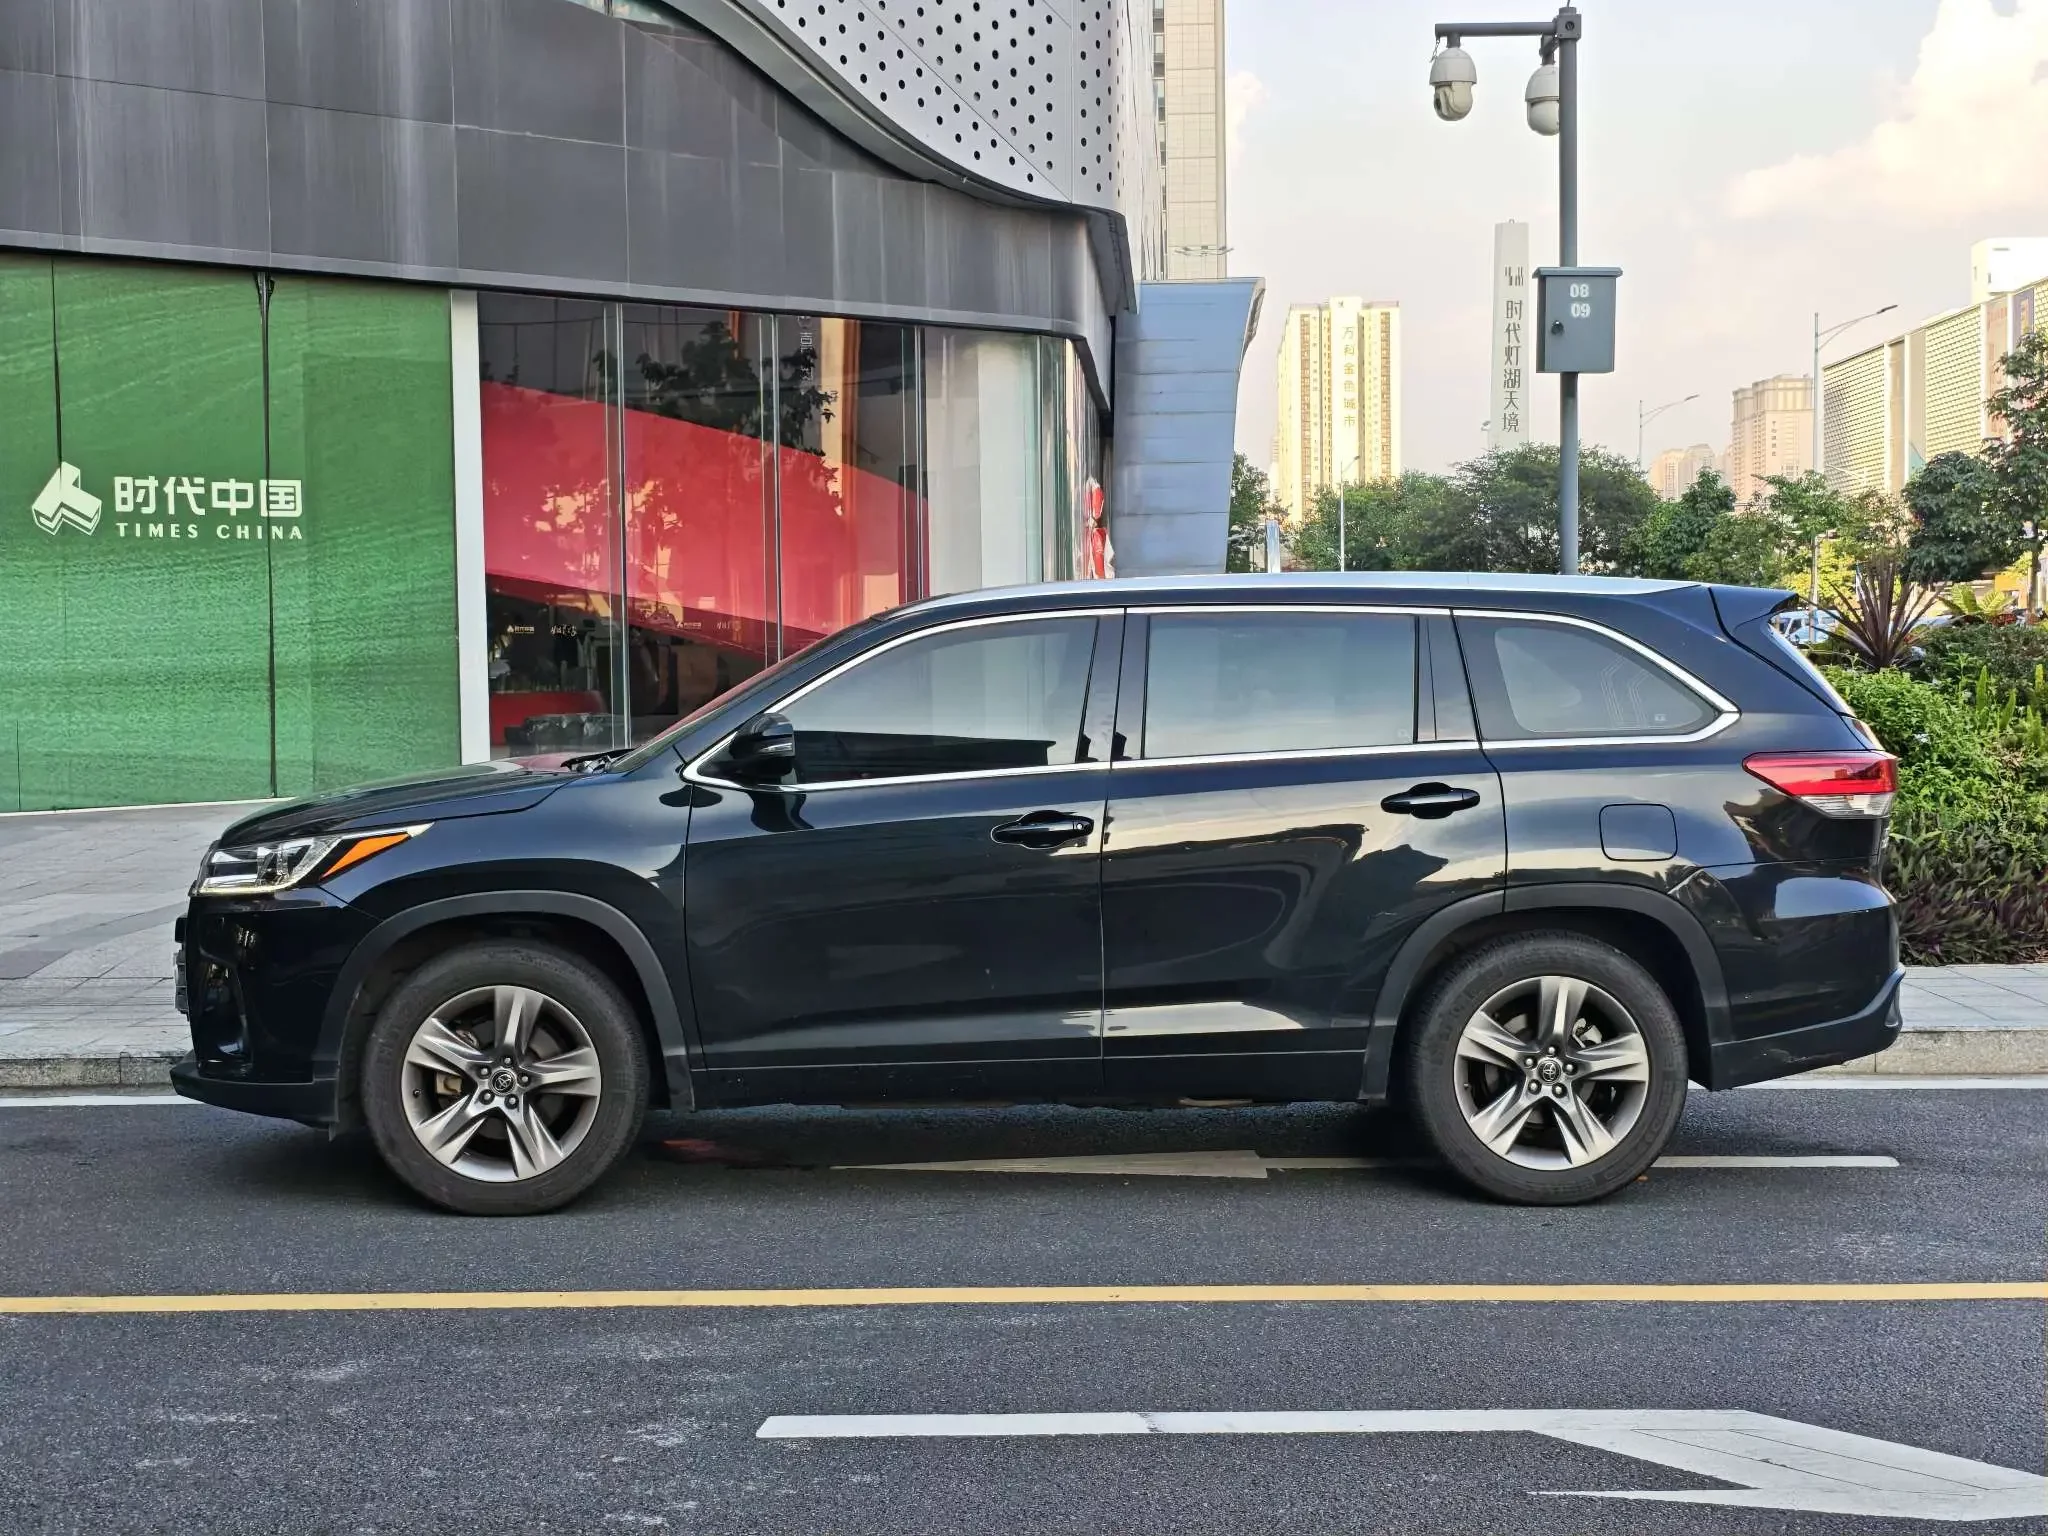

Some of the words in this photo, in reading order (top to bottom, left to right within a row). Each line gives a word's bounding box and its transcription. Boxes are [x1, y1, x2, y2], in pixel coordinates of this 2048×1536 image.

[1569, 283, 1590, 298] 08
[1571, 303, 1591, 318] 09
[1501, 299, 1523, 433] 时代灯湖天境
[113, 475, 303, 518] 时代中国
[115, 522, 199, 538] TIMES
[216, 523, 303, 540] CHINA
